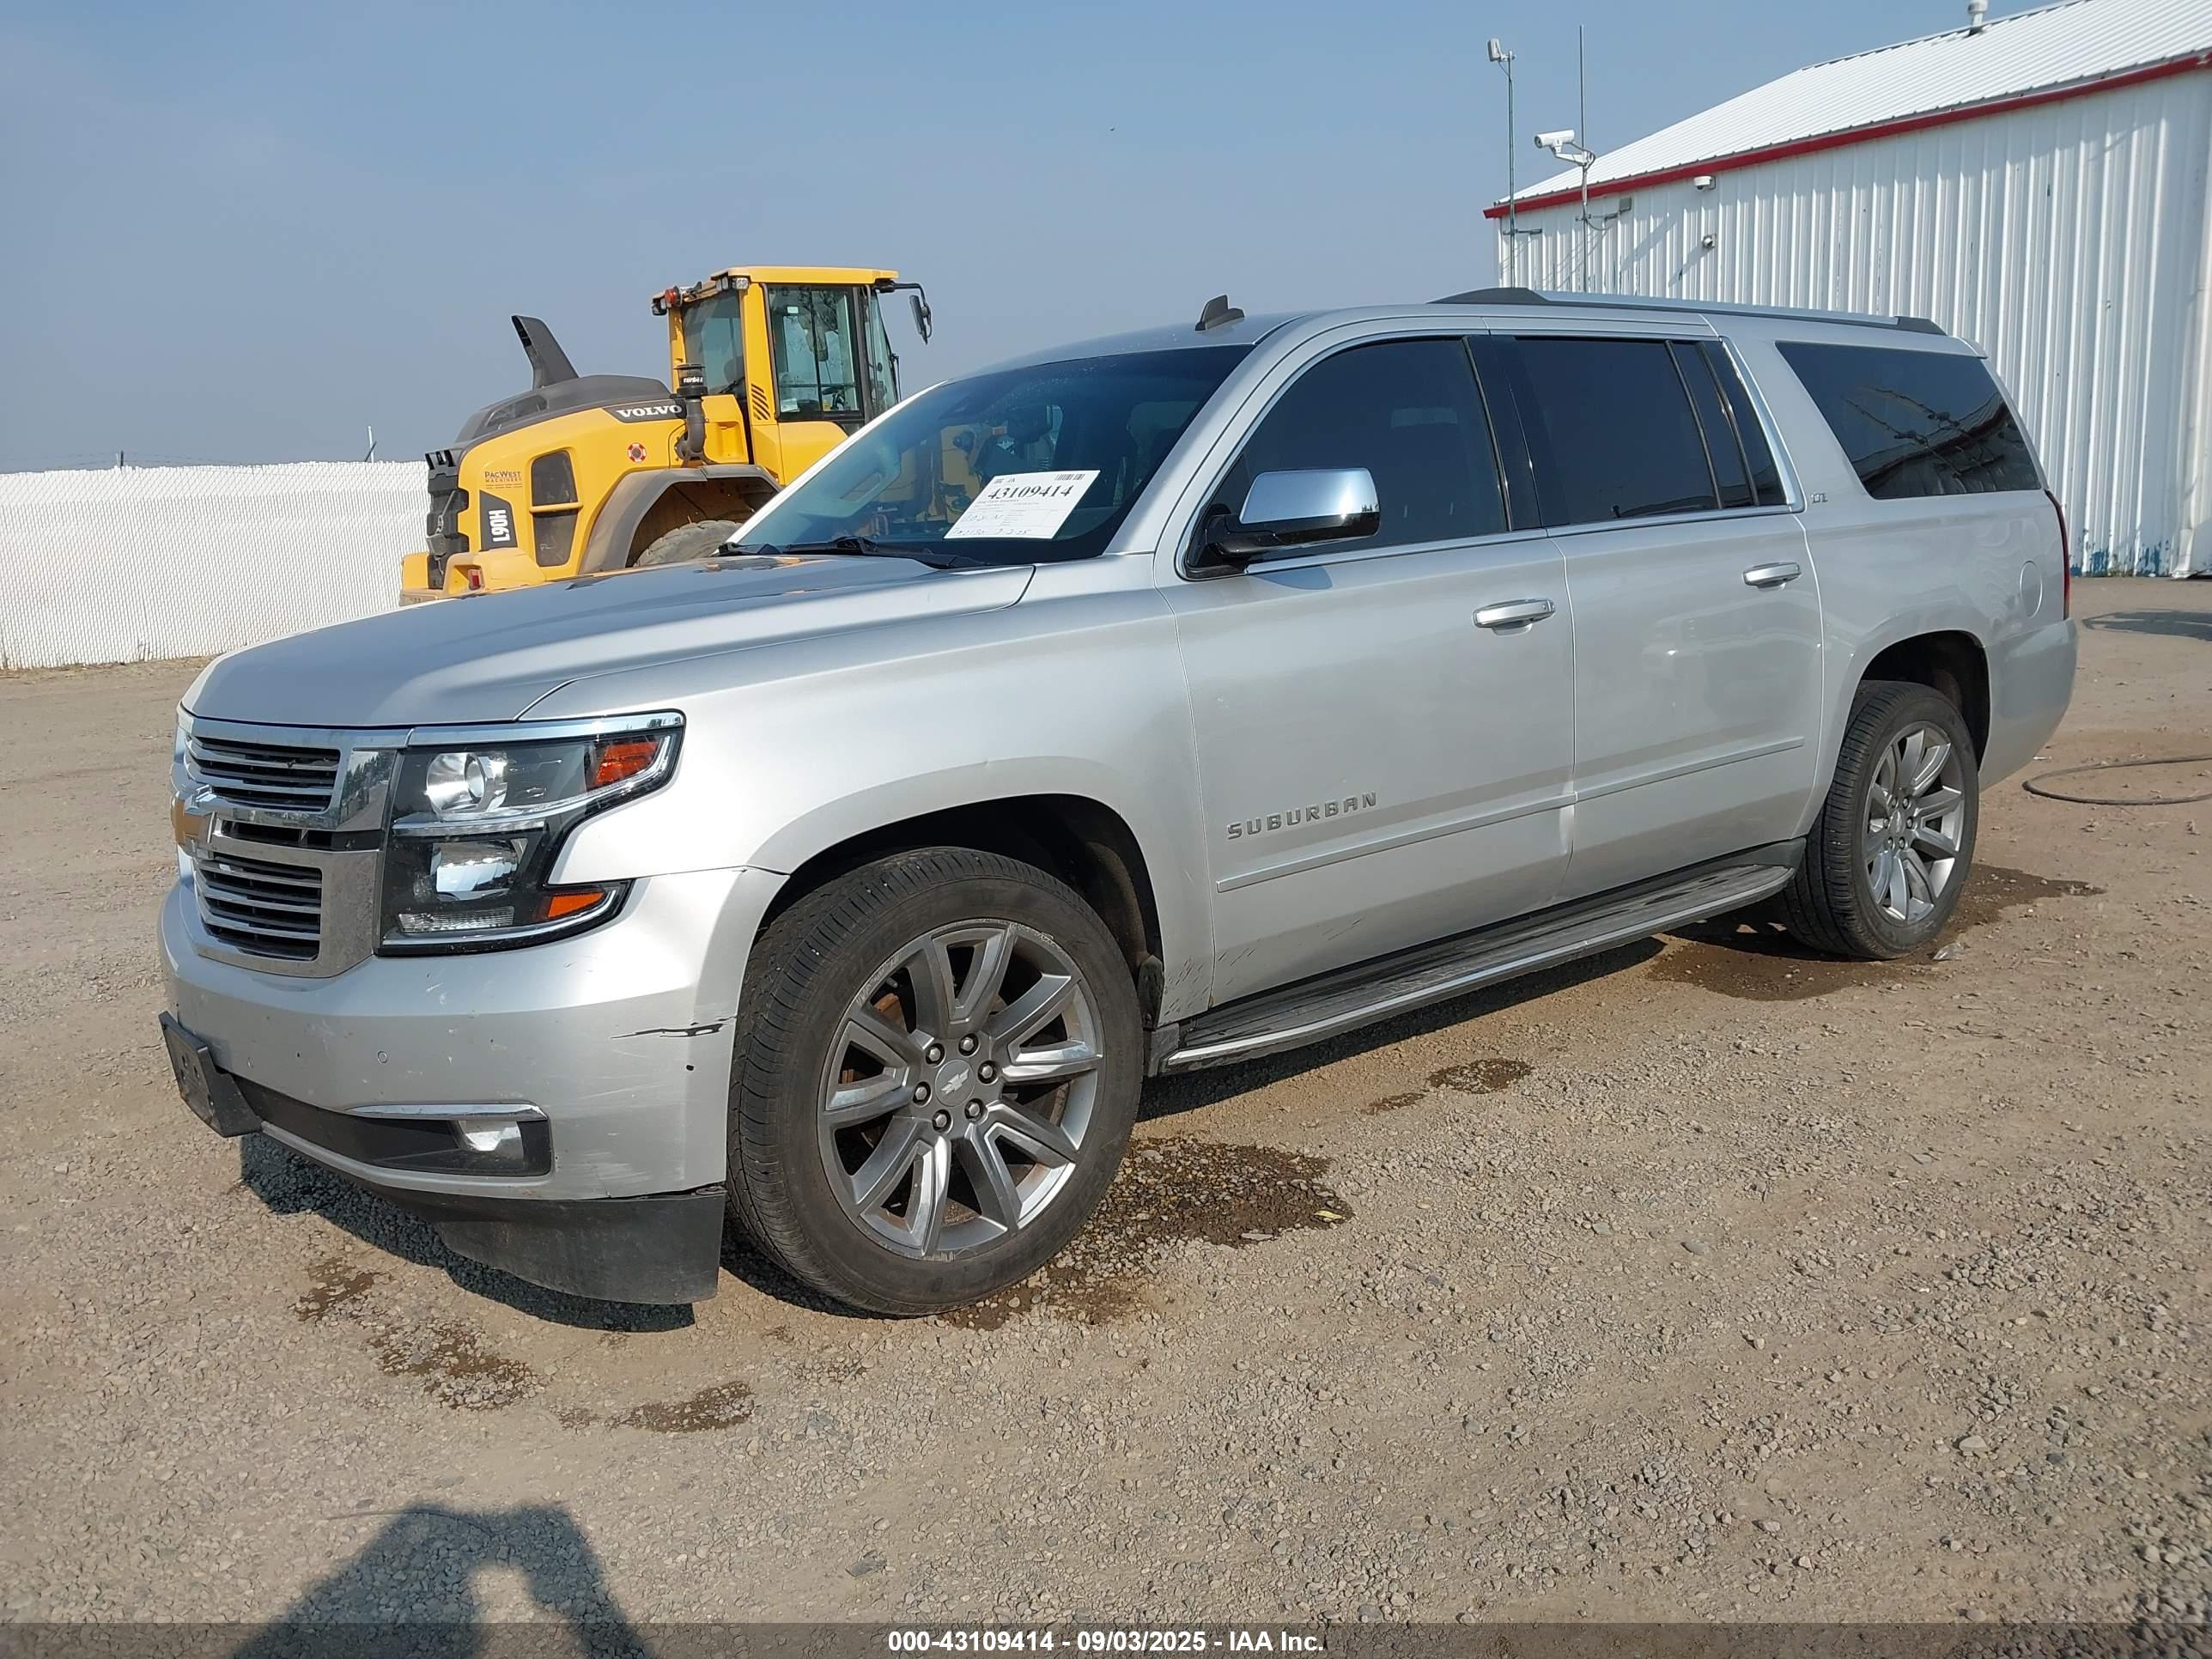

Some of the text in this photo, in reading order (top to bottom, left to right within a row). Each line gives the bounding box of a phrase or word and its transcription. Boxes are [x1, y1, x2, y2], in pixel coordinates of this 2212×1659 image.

[616, 404, 683, 418] VOLVO
[988, 484, 1074, 500] 43109414
[488, 509, 511, 543] L90H
[1226, 791, 1377, 841] SUBURBAN
